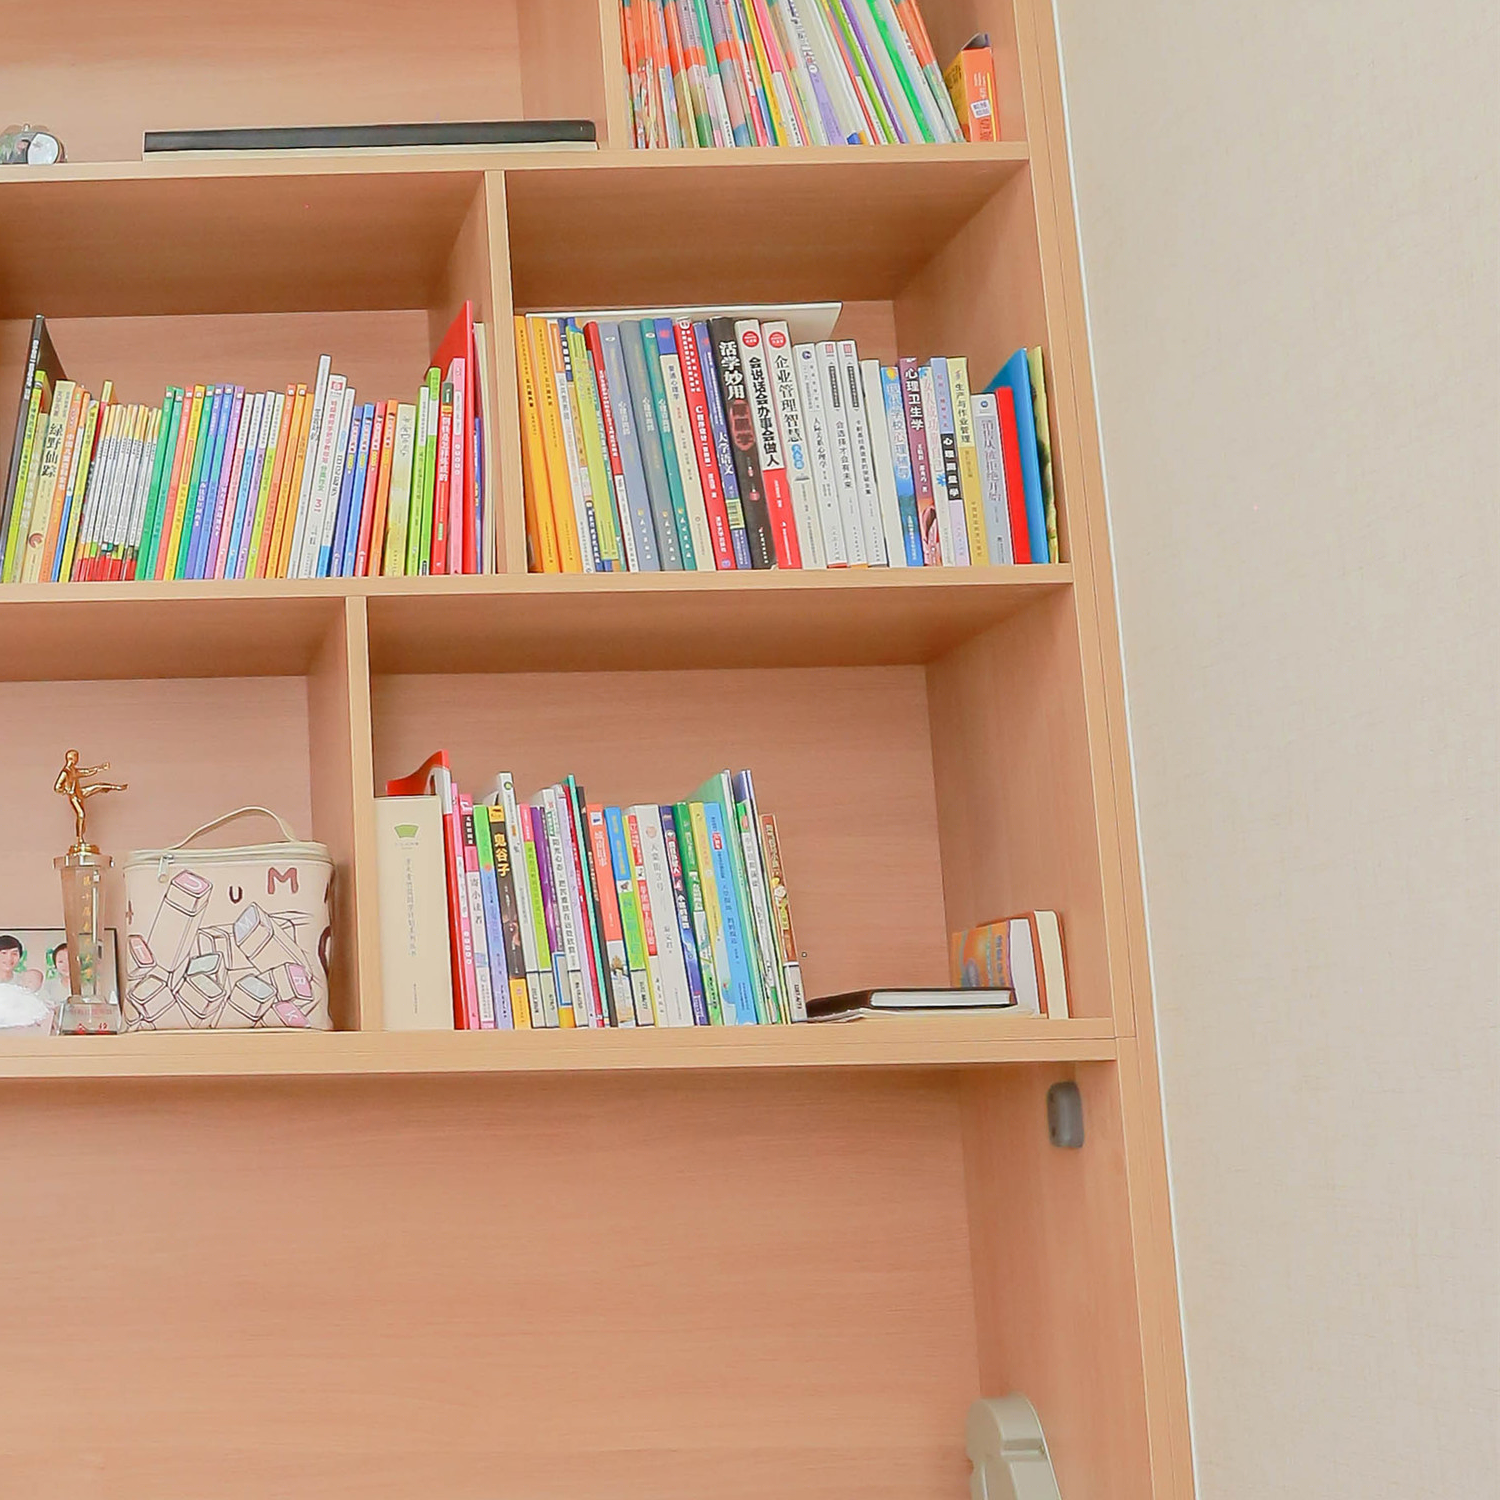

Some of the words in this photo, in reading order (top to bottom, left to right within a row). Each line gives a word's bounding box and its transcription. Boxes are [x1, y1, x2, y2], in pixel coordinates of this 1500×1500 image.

[718, 341, 745, 400] 活学妙用
[774, 355, 802, 443] 企业管理智慧
[905, 367, 924, 431] 心理卫生学
[748, 356, 780, 467] 会说话会办事会做人
[954, 383, 971, 443] 生产与作业管理
[41, 423, 64, 477] 绿野仙踪
[717, 431, 734, 476] 大学语文
[267, 866, 300, 895] M
